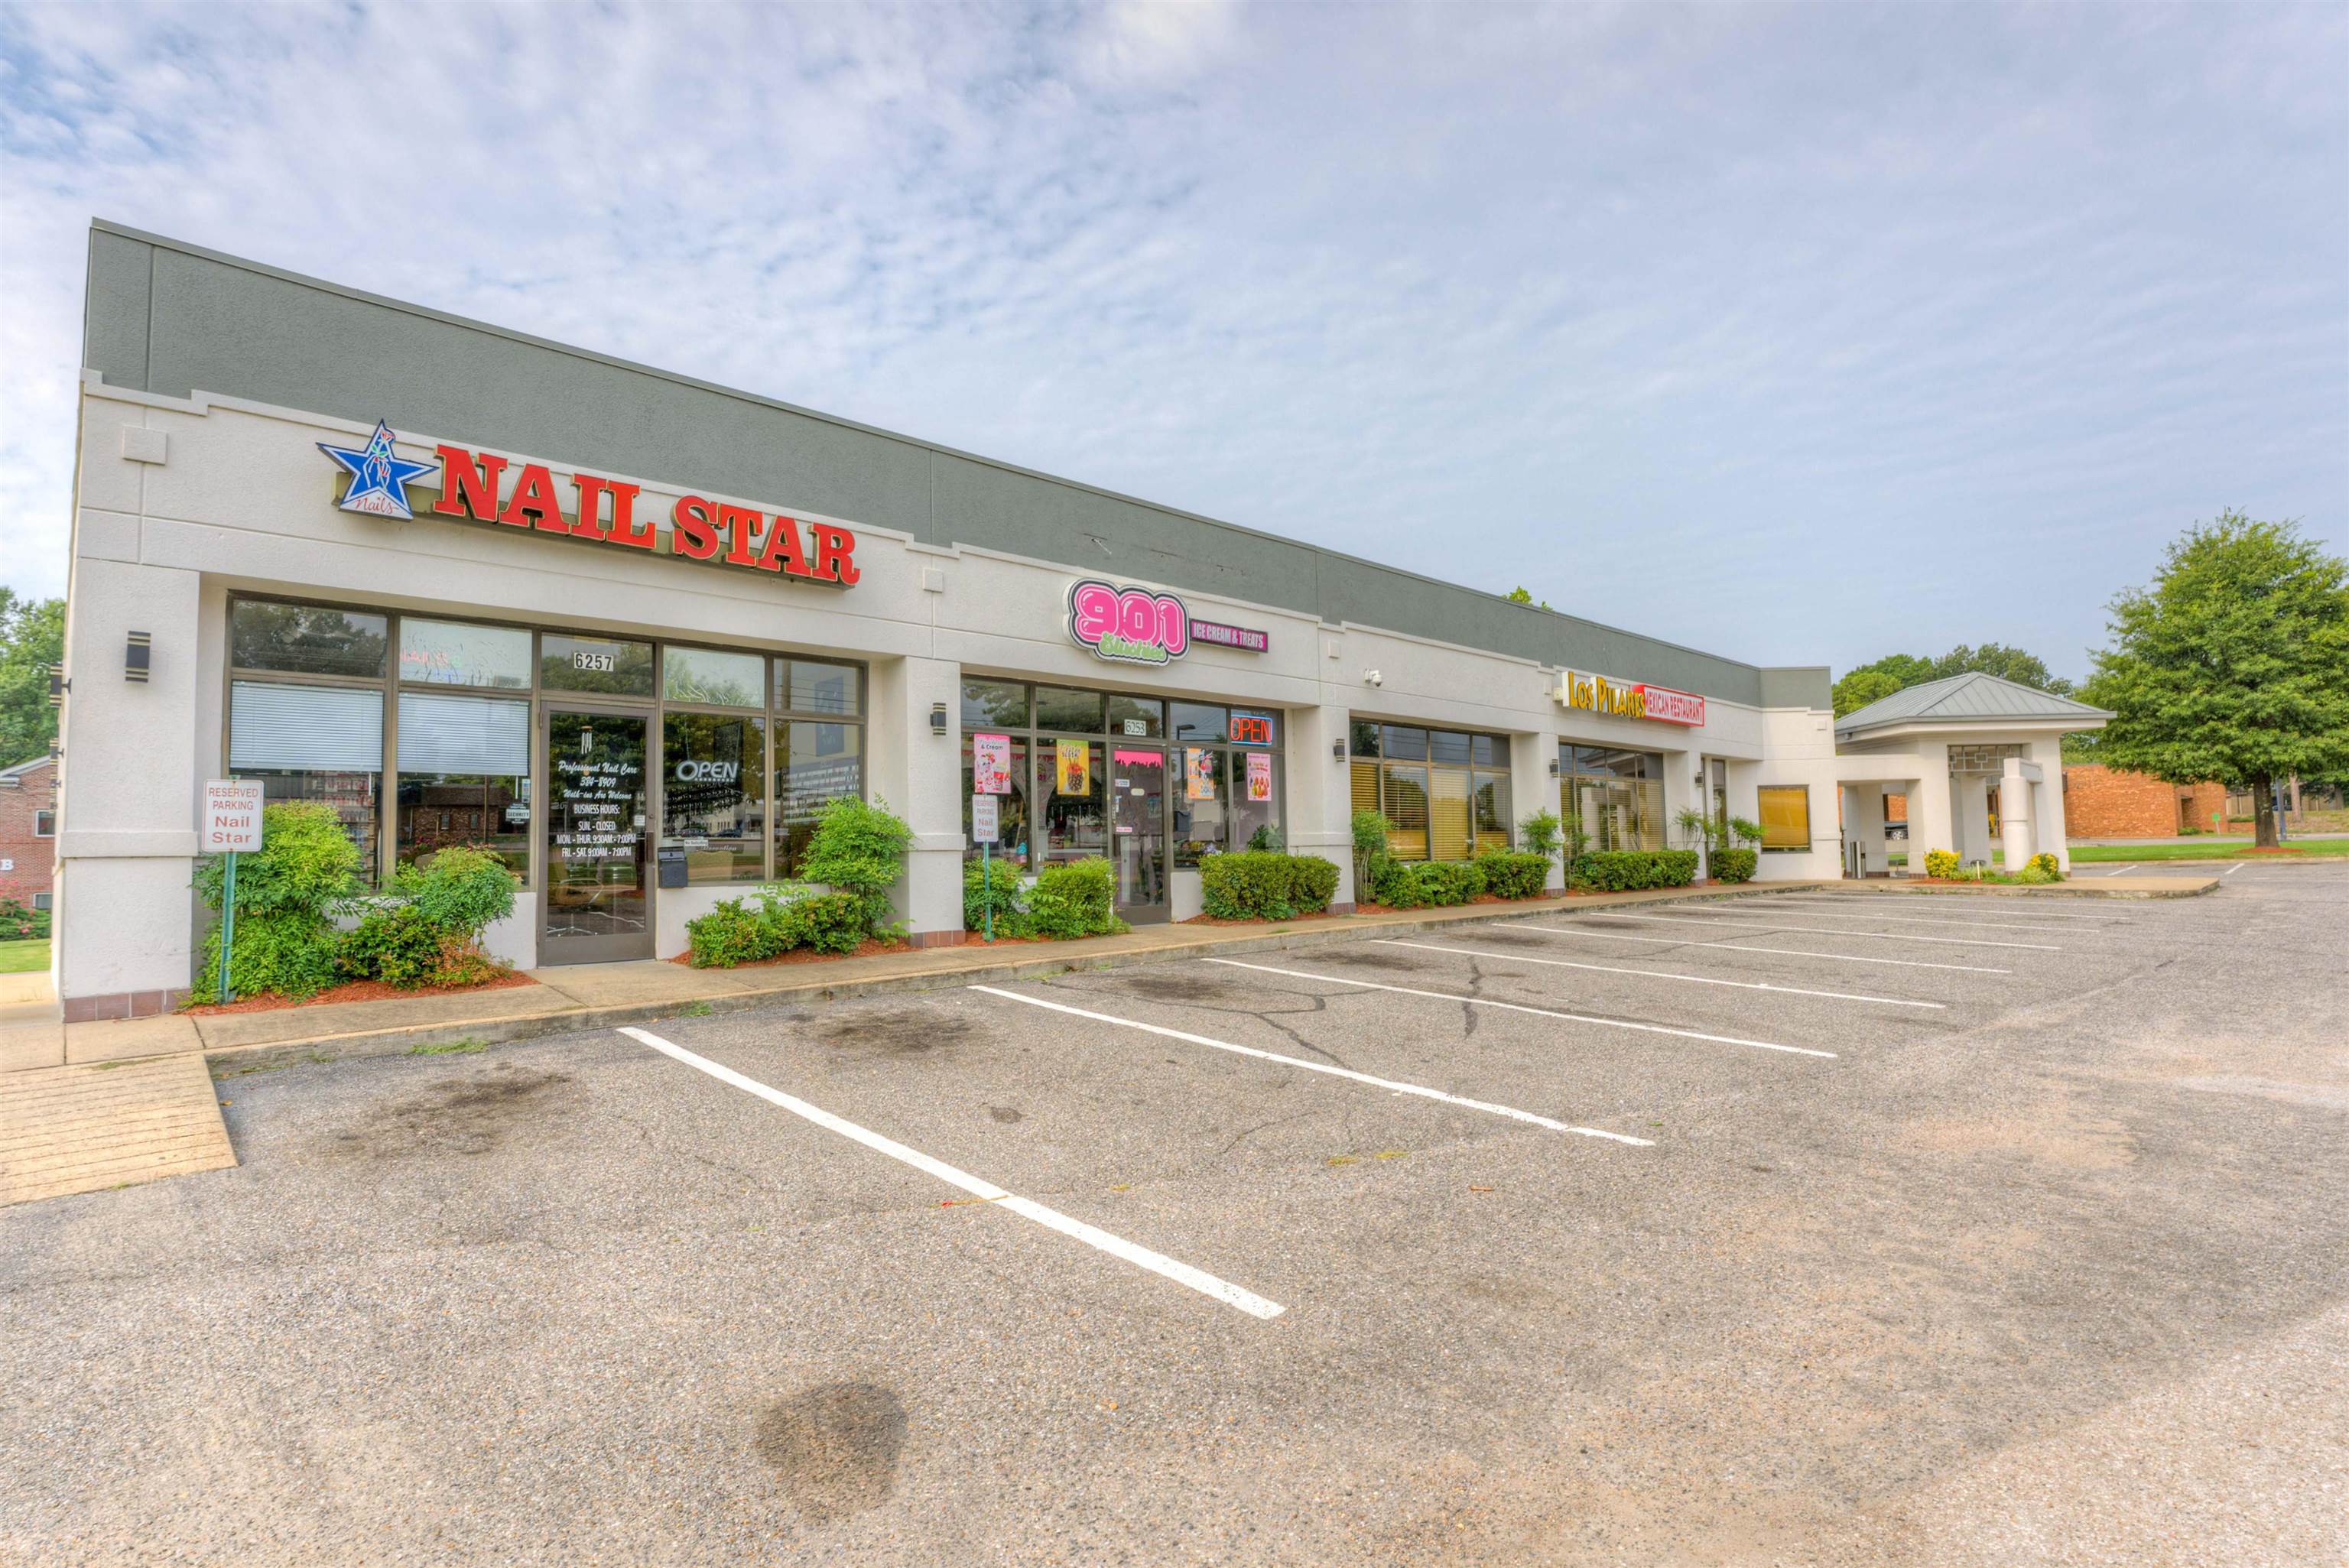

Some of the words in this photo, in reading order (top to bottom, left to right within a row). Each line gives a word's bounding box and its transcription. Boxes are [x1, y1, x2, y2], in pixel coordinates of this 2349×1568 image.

[355, 497, 399, 514] Nails
[433, 444, 657, 549] NAIL
[673, 495, 860, 585] STAR
[1074, 584, 1185, 654] 901
[1194, 623, 1206, 638] ICE
[1207, 625, 1231, 643] CREAM
[1232, 629, 1238, 644] &
[1239, 631, 1264, 649] TREATS
[575, 653, 612, 670] 6257
[1645, 690, 1670, 716] MEXICAN
[1670, 696, 1703, 722] RESTAURANT
[1126, 720, 1145, 734] 6253
[1230, 717, 1272, 743] OPEN
[558, 760, 600, 774] Professional
[602, 762, 619, 773] Nail
[620, 763, 637, 775] Care
[676, 760, 739, 781] OPEN
[209, 787, 258, 797] RESERVED
[593, 790, 606, 799] Are
[608, 790, 632, 800] Welcome
[213, 800, 254, 810] PARKING
[573, 803, 599, 814] BUSINESS
[599, 804, 620, 814] HOURS:
[215, 816, 250, 827] Nail
[596, 821, 616, 831] CLOSED
[212, 832, 252, 843] Star
[617, 834, 636, 843] 7:00PM
[612, 847, 632, 856] 7:00PM
